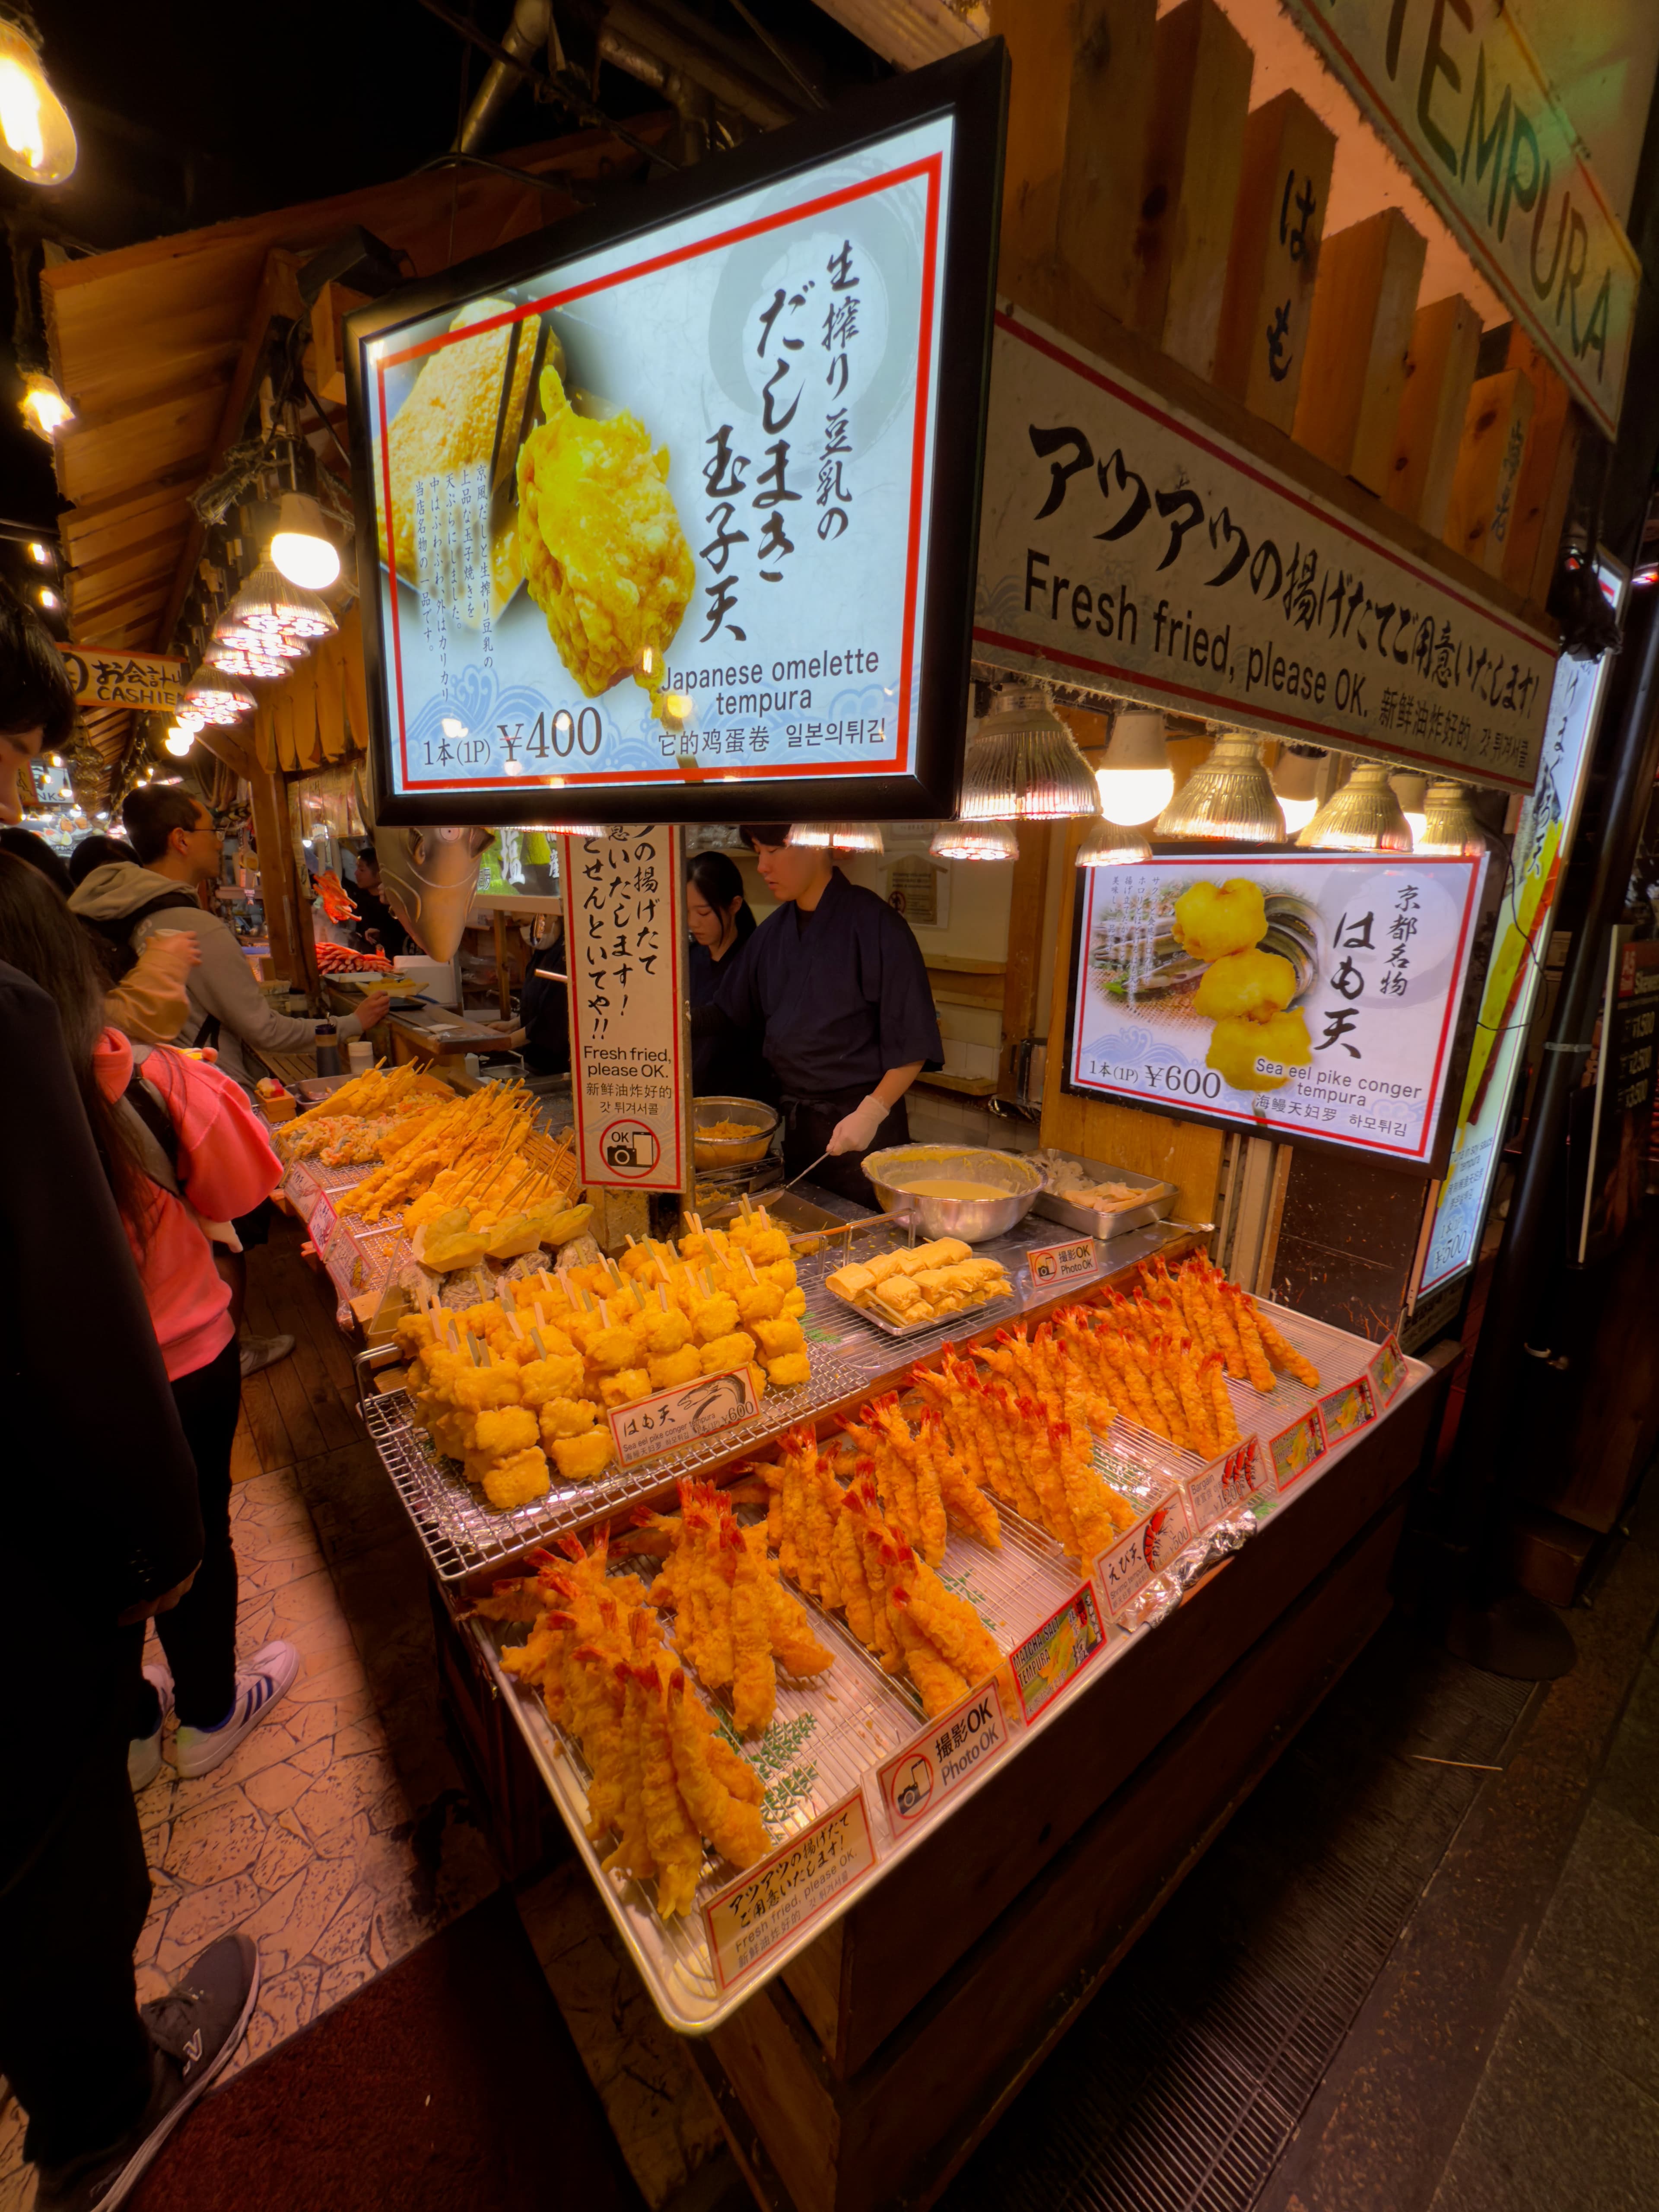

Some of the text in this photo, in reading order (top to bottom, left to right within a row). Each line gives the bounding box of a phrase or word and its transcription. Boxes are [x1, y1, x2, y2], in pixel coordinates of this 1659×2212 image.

[817, 239, 861, 541] 生搾り豆乳の
[752, 280, 815, 582] だしまき
[445, 472, 462, 629] 天ぷらにしました。
[460, 470, 475, 619] 上品な玉子焼きを
[699, 424, 751, 643] 玉子天
[415, 481, 434, 652] 当店名物の一品です。
[1024, 548, 1368, 718] Fresh fried, please OK.
[661, 648, 880, 693] Japanese omelette
[716, 686, 812, 718] tempura
[423, 706, 603, 767] 1本(1P) ¥400
[658, 724, 770, 757] 它的鸡蛋卷
[785, 718, 886, 748] 일본의튀김
[1379, 884, 1421, 997] 京都名物
[1314, 912, 1376, 1059] はも天
[584, 1046, 671, 1064] Fresh fried,
[588, 1062, 669, 1078] please OK.
[586, 1082, 672, 1099] 新鲜油炸好的
[1089, 1059, 1221, 1099] 1本(1P) ¥600
[1256, 1058, 1423, 1099] Sea eel pike conger
[1297, 1082, 1367, 1107] tempura
[600, 1101, 611, 1113] 갓
[1255, 1094, 1337, 1122] 海鳗天妇罗
[1348, 1114, 1407, 1137] 하모튀김
[611, 1131, 629, 1143] OK
[1058, 1245, 1091, 1264] 撮影OK
[1061, 1259, 1093, 1275] Photo OK
[623, 1404, 675, 1437] はも天
[623, 1413, 716, 1452] Sea eel pike conger tempura
[1191, 1474, 1215, 1495] Bargain
[1012, 1634, 1043, 1670] MATCHA
[1042, 1616, 1060, 1641] SALT
[1017, 1648, 1051, 1688] TEMPURA
[935, 1696, 993, 1763] 撮影OK
[941, 1723, 999, 1786] Photo OK
[736, 1920, 769, 1953] Fresh
[804, 1866, 837, 1901] please
